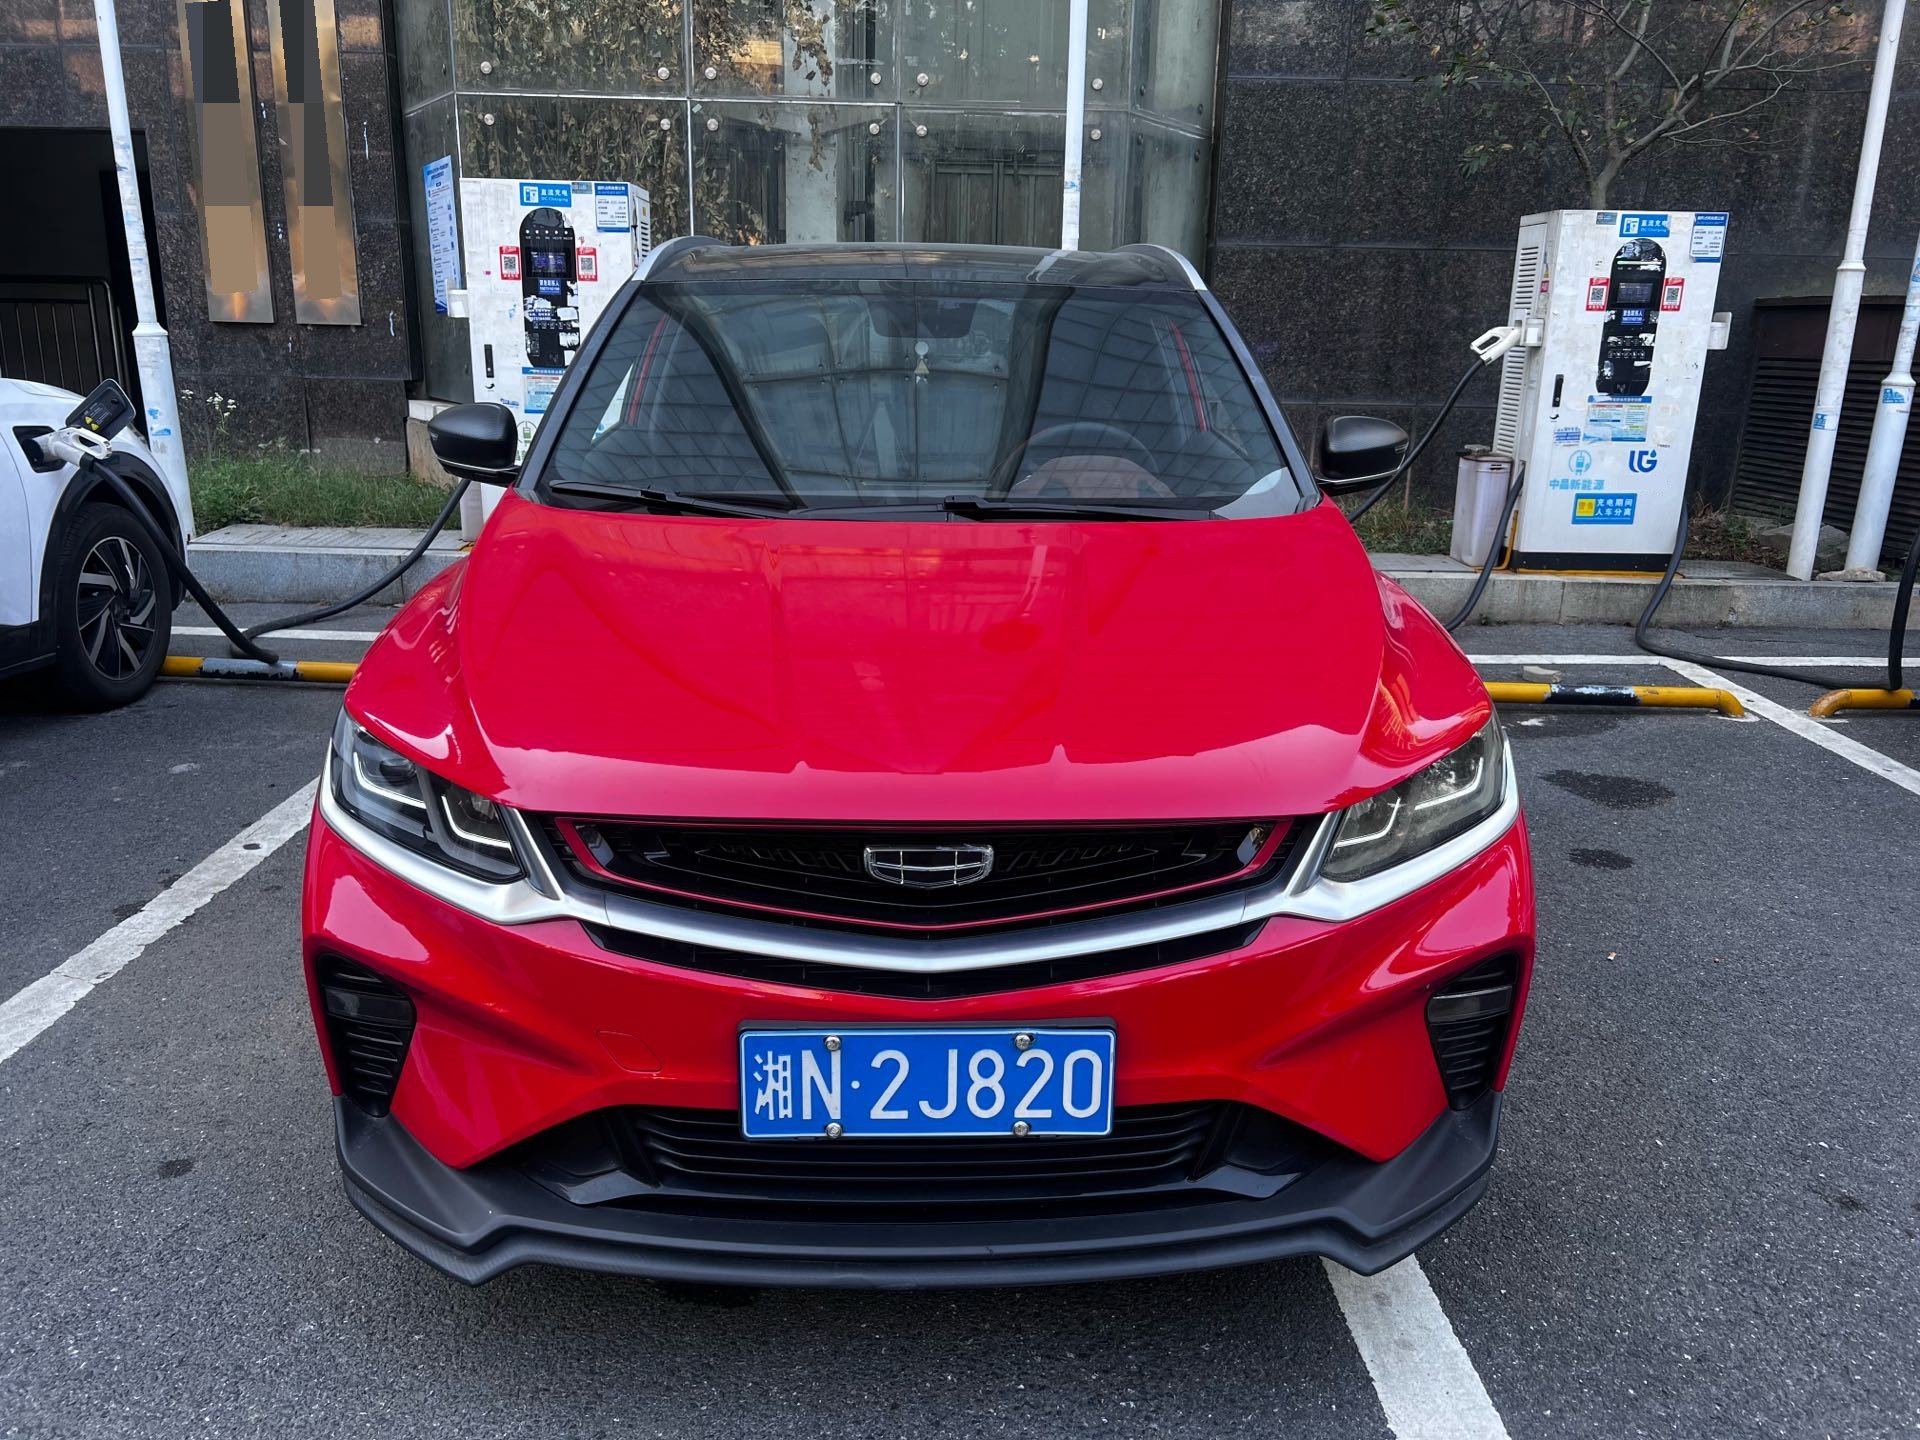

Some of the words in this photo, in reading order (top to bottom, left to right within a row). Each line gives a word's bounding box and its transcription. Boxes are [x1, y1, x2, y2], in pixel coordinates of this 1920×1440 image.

[541, 189, 568, 197] 直流充电
[1596, 498, 1633, 507] 充电期间
[1595, 508, 1632, 516] 人车分离
